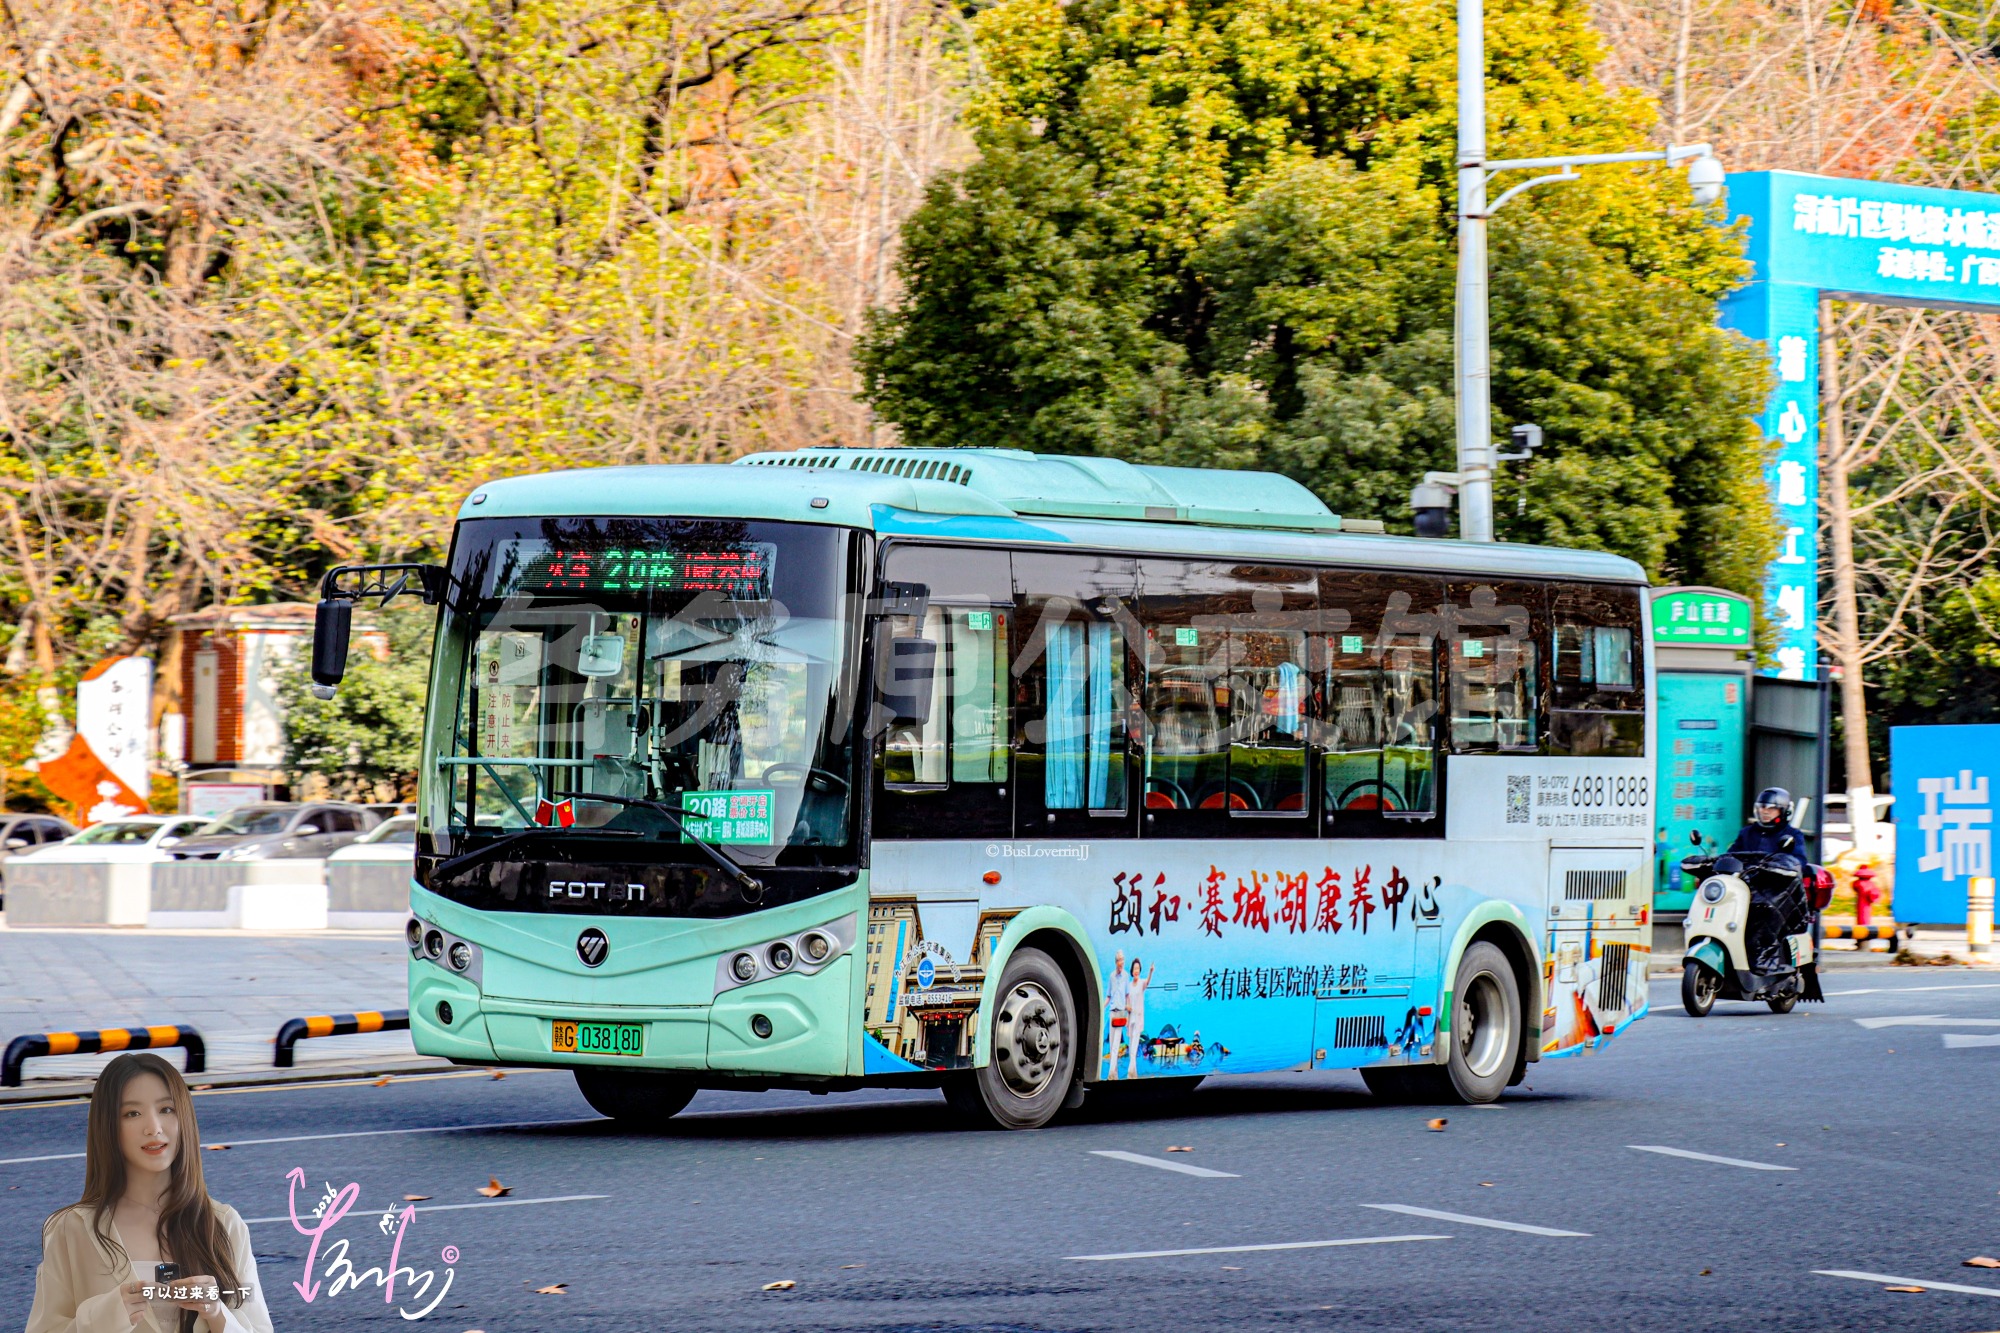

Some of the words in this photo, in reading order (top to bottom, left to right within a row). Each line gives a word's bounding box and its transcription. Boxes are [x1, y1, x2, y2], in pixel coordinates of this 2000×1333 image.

[729, 794, 767, 806] 空调开启
[1572, 776, 1649, 807] 6881888
[1917, 769, 1992, 881] 瑞
[549, 881, 645, 901] FOTN
[1108, 863, 1442, 938] 颐和·赛城湖康养中心
[1185, 963, 1368, 1001] 一家有康复医院的养老院
